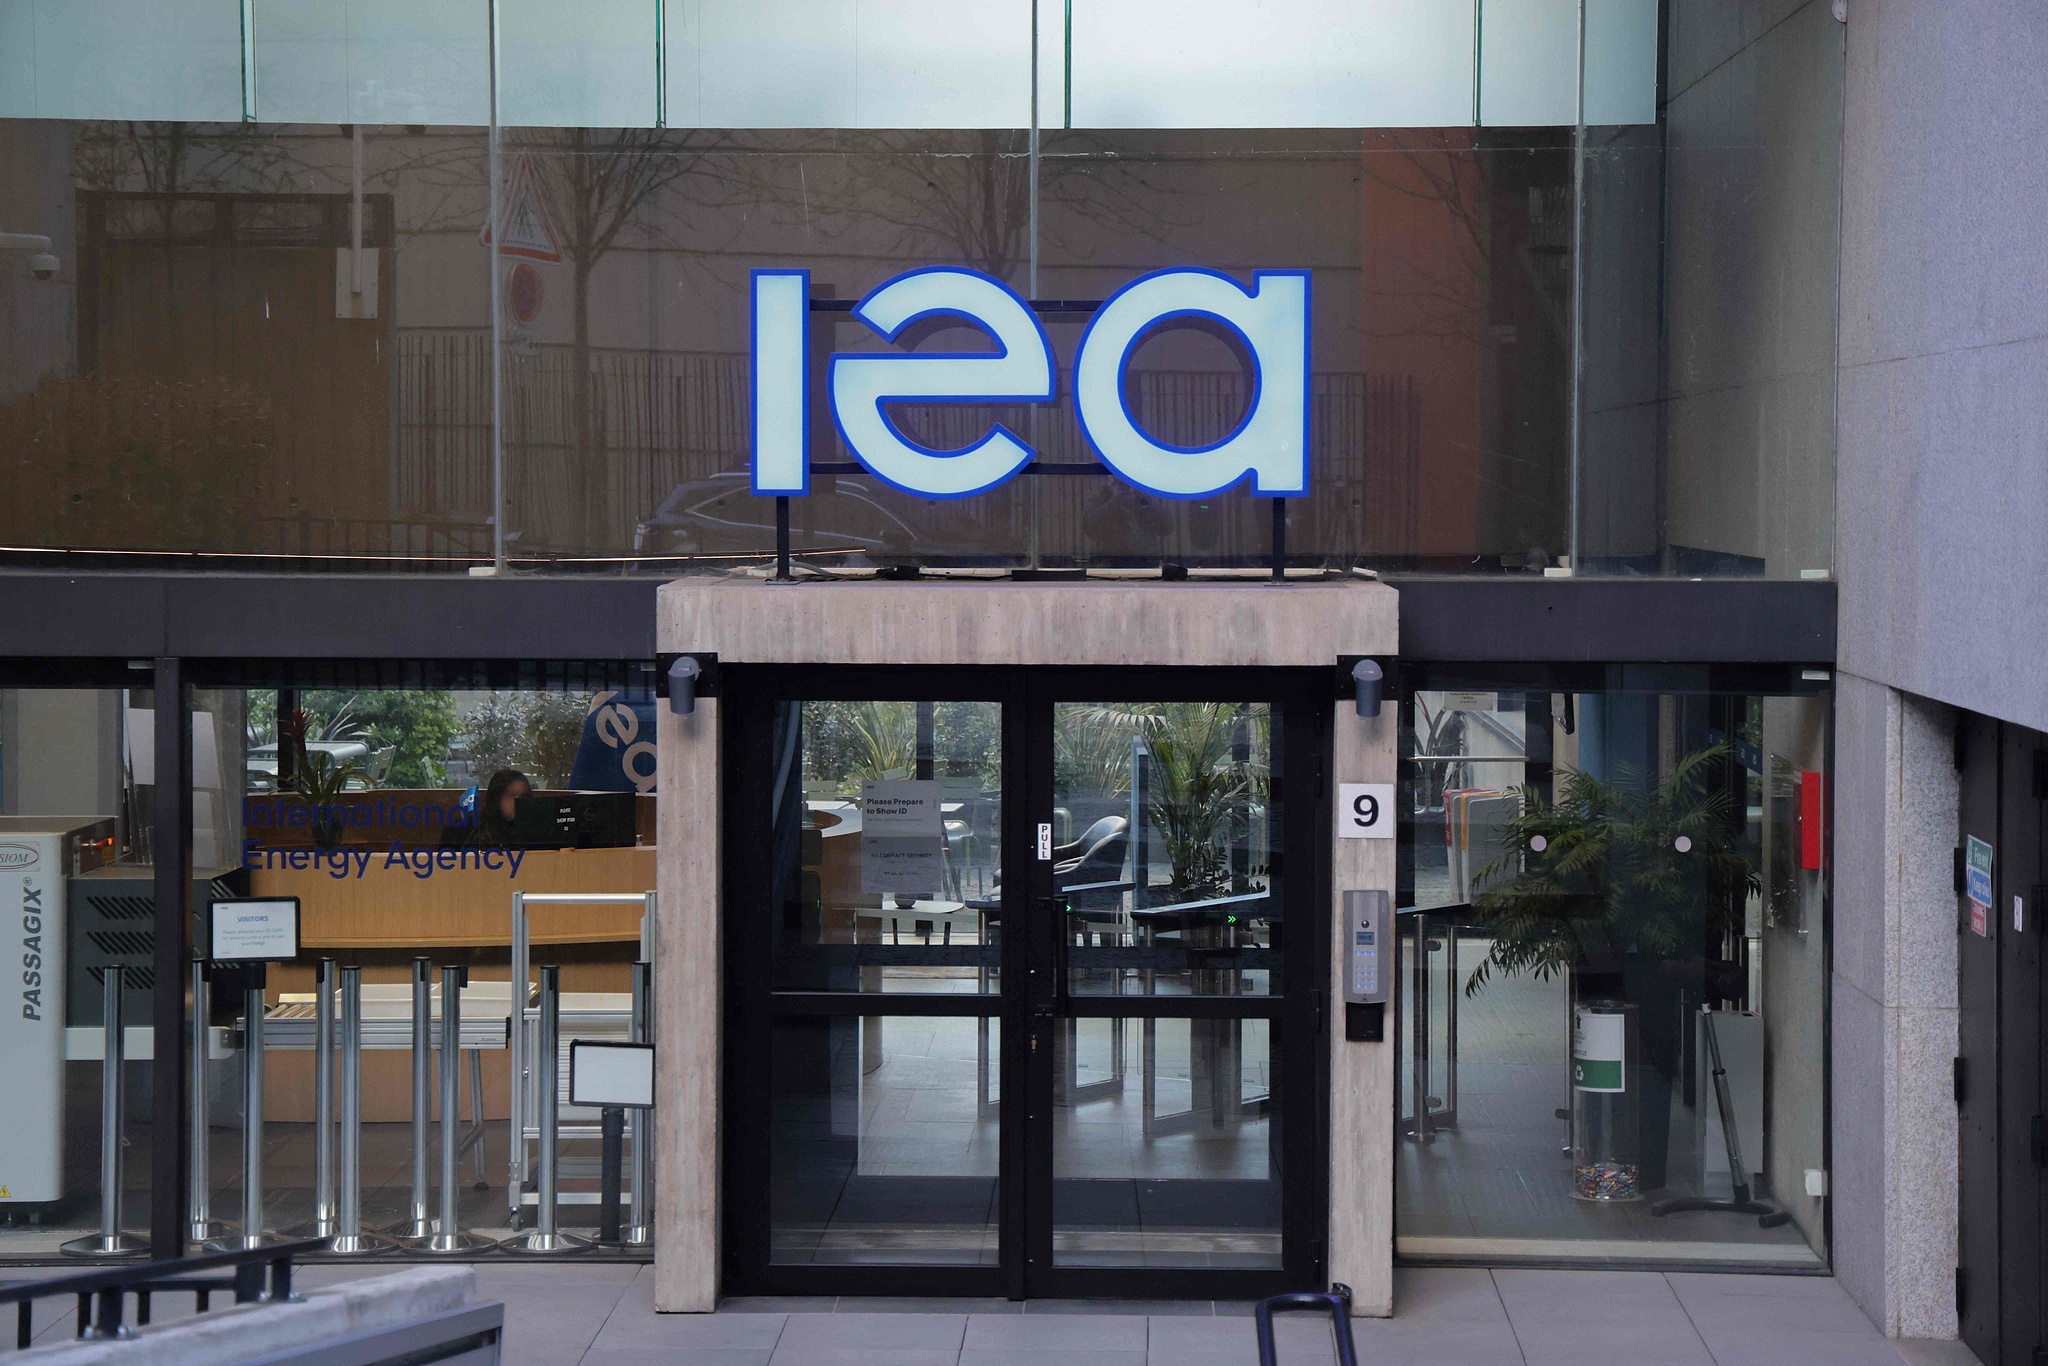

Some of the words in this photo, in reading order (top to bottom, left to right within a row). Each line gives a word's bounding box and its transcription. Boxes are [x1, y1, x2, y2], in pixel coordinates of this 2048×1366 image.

[242, 797, 479, 827] International
[1353, 794, 1379, 827] 9
[242, 840, 373, 880] Energy
[383, 840, 526, 880] Agency
